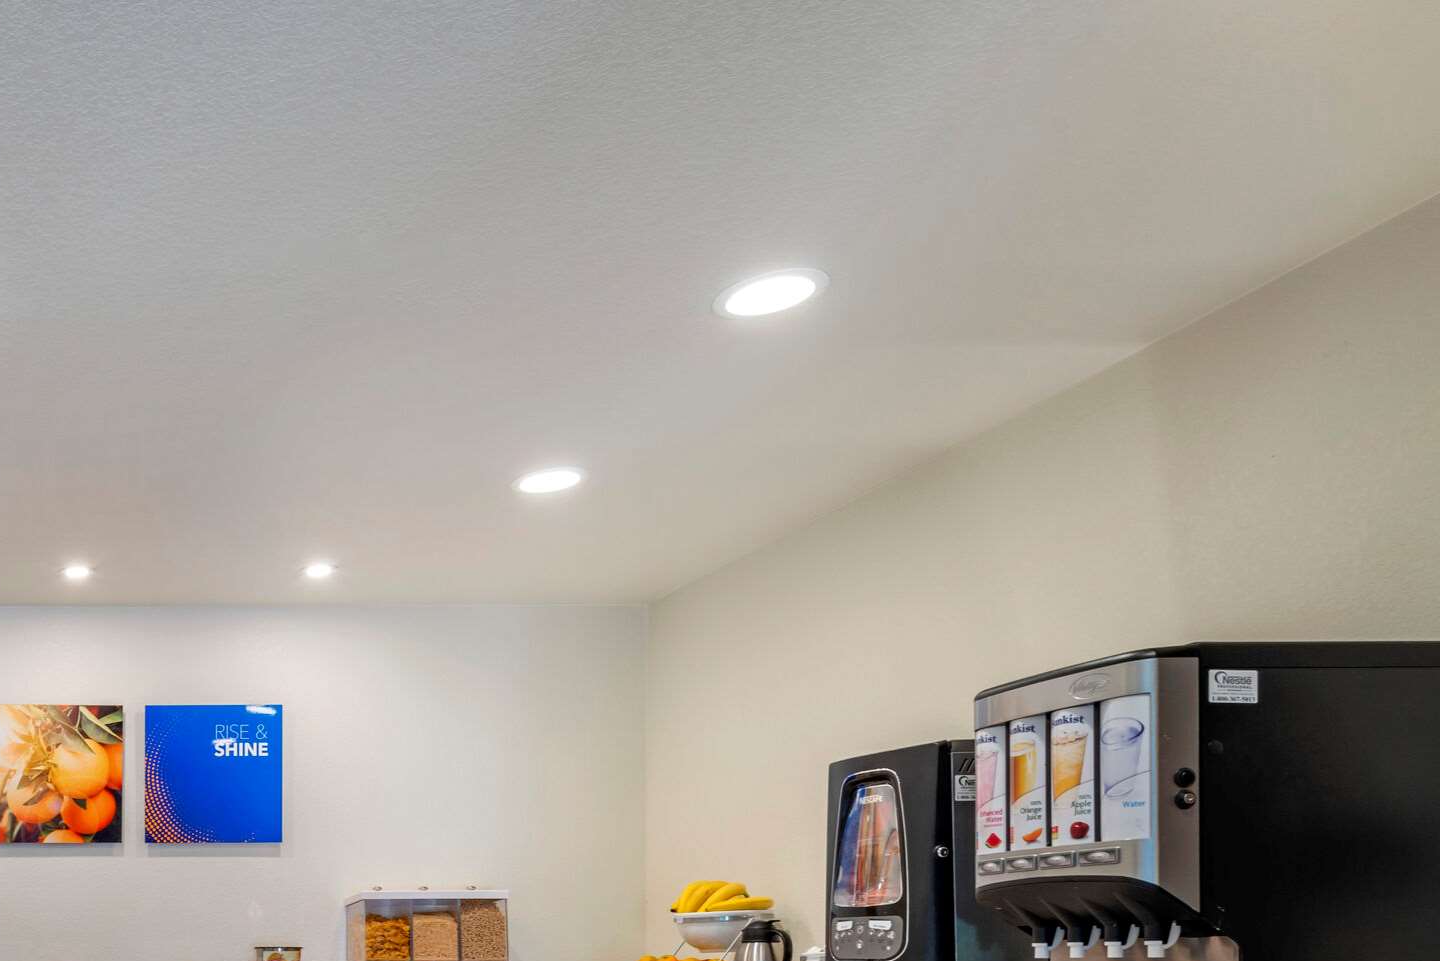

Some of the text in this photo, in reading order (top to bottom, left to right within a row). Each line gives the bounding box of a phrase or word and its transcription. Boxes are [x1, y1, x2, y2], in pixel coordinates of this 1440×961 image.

[215, 723, 268, 740] RISE &
[214, 742, 269, 757] SHINE
[1070, 800, 1092, 810] Apple
[1121, 800, 1145, 808] Water
[1019, 807, 1042, 815] Orange
[1074, 808, 1092, 817] Juice
[1026, 813, 1042, 821] Juice
